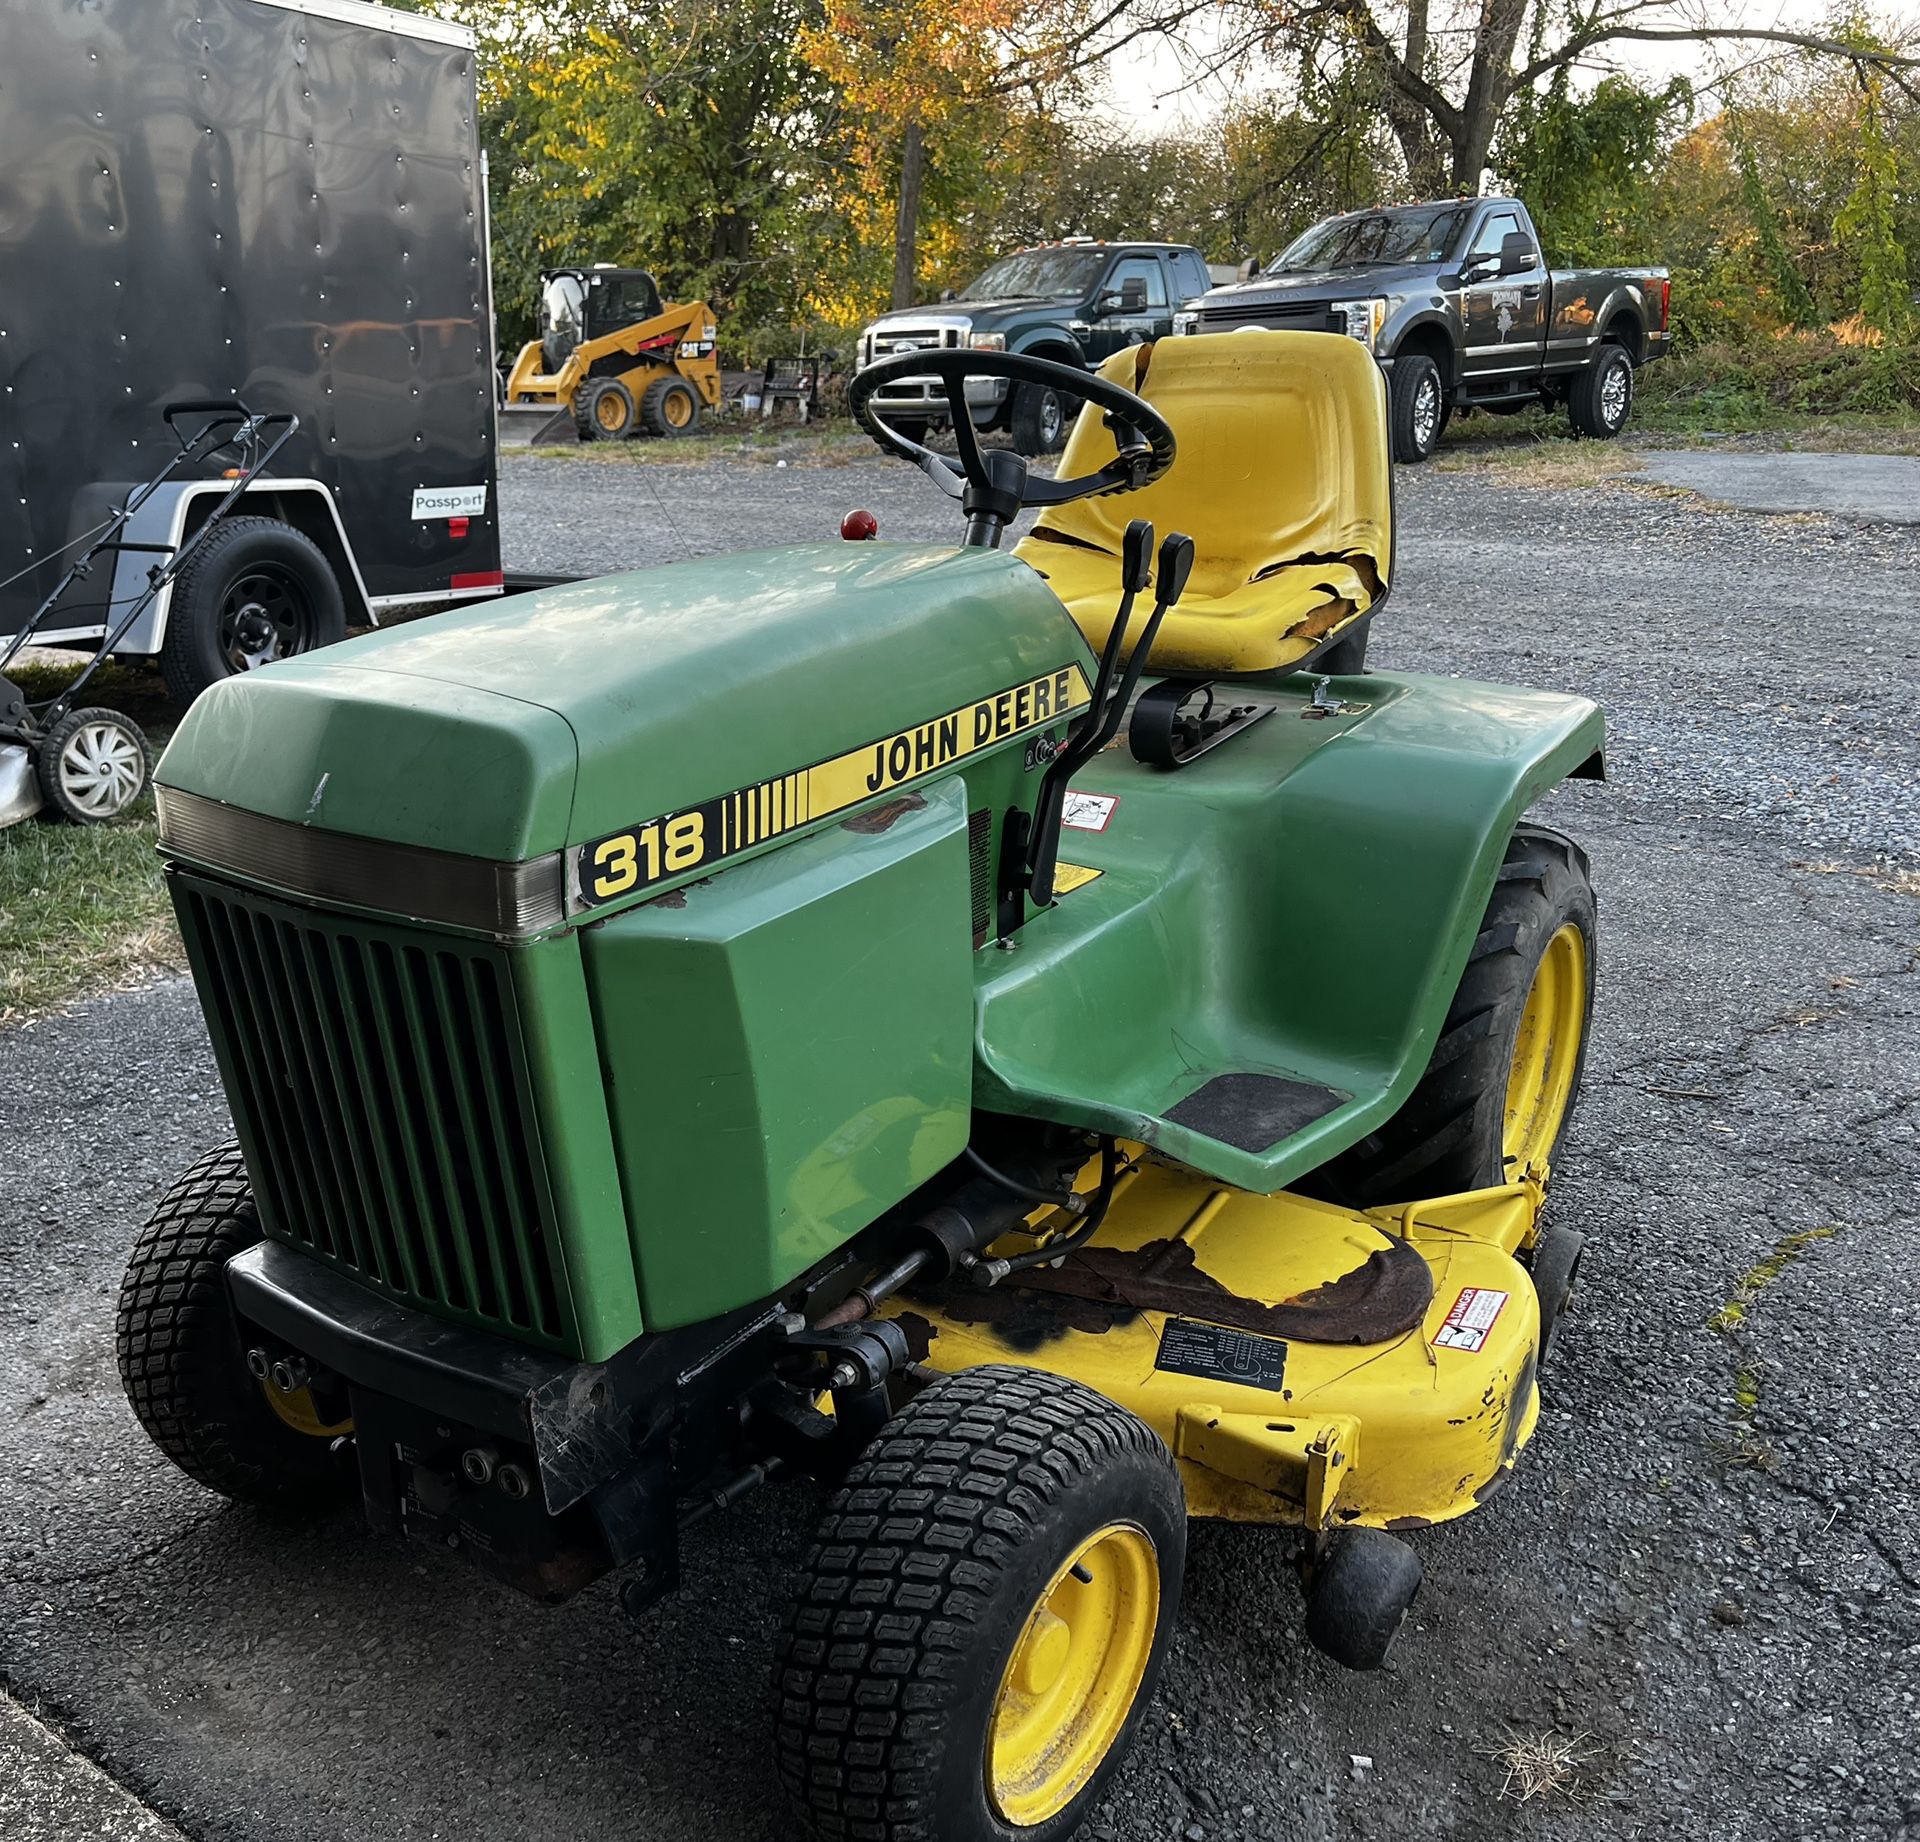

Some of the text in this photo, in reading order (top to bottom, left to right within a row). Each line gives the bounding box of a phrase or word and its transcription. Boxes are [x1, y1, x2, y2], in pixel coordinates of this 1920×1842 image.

[416, 494, 484, 509] Passport
[866, 670, 1069, 791] JOHN DEERE
[594, 811, 704, 897] 318
[1449, 1289, 1477, 1320] DANGER
